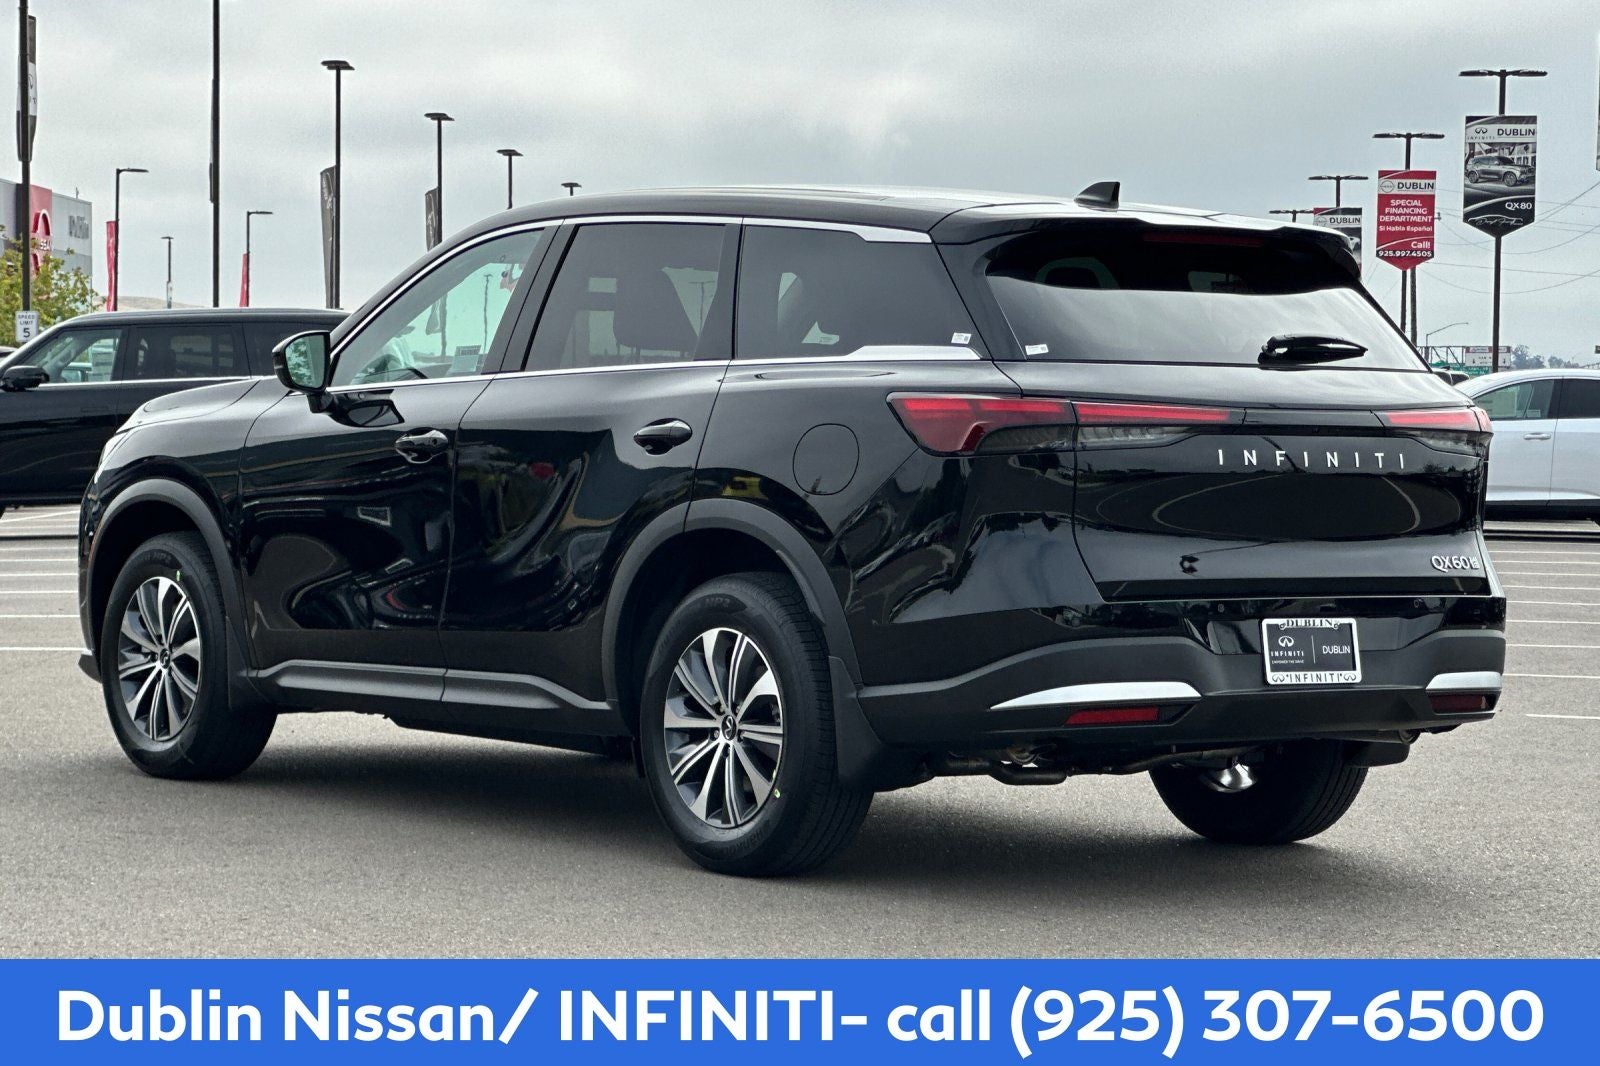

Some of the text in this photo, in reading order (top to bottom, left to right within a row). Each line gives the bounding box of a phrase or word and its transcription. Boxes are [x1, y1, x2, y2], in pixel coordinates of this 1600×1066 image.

[1497, 128, 1536, 136] DUBLIN
[1397, 182, 1434, 190] DUBLIN
[1505, 201, 1533, 211] QX80
[1406, 225, 1433, 233] Español
[1411, 241, 1431, 249] Call!
[23, 327, 31, 338] 5
[1218, 449, 1404, 469] INFINITI
[1431, 555, 1470, 572] QX60
[1285, 618, 1333, 627] DUBLIN
[1322, 645, 1351, 654] DUBLIN
[1289, 673, 1341, 682] INFINITI
